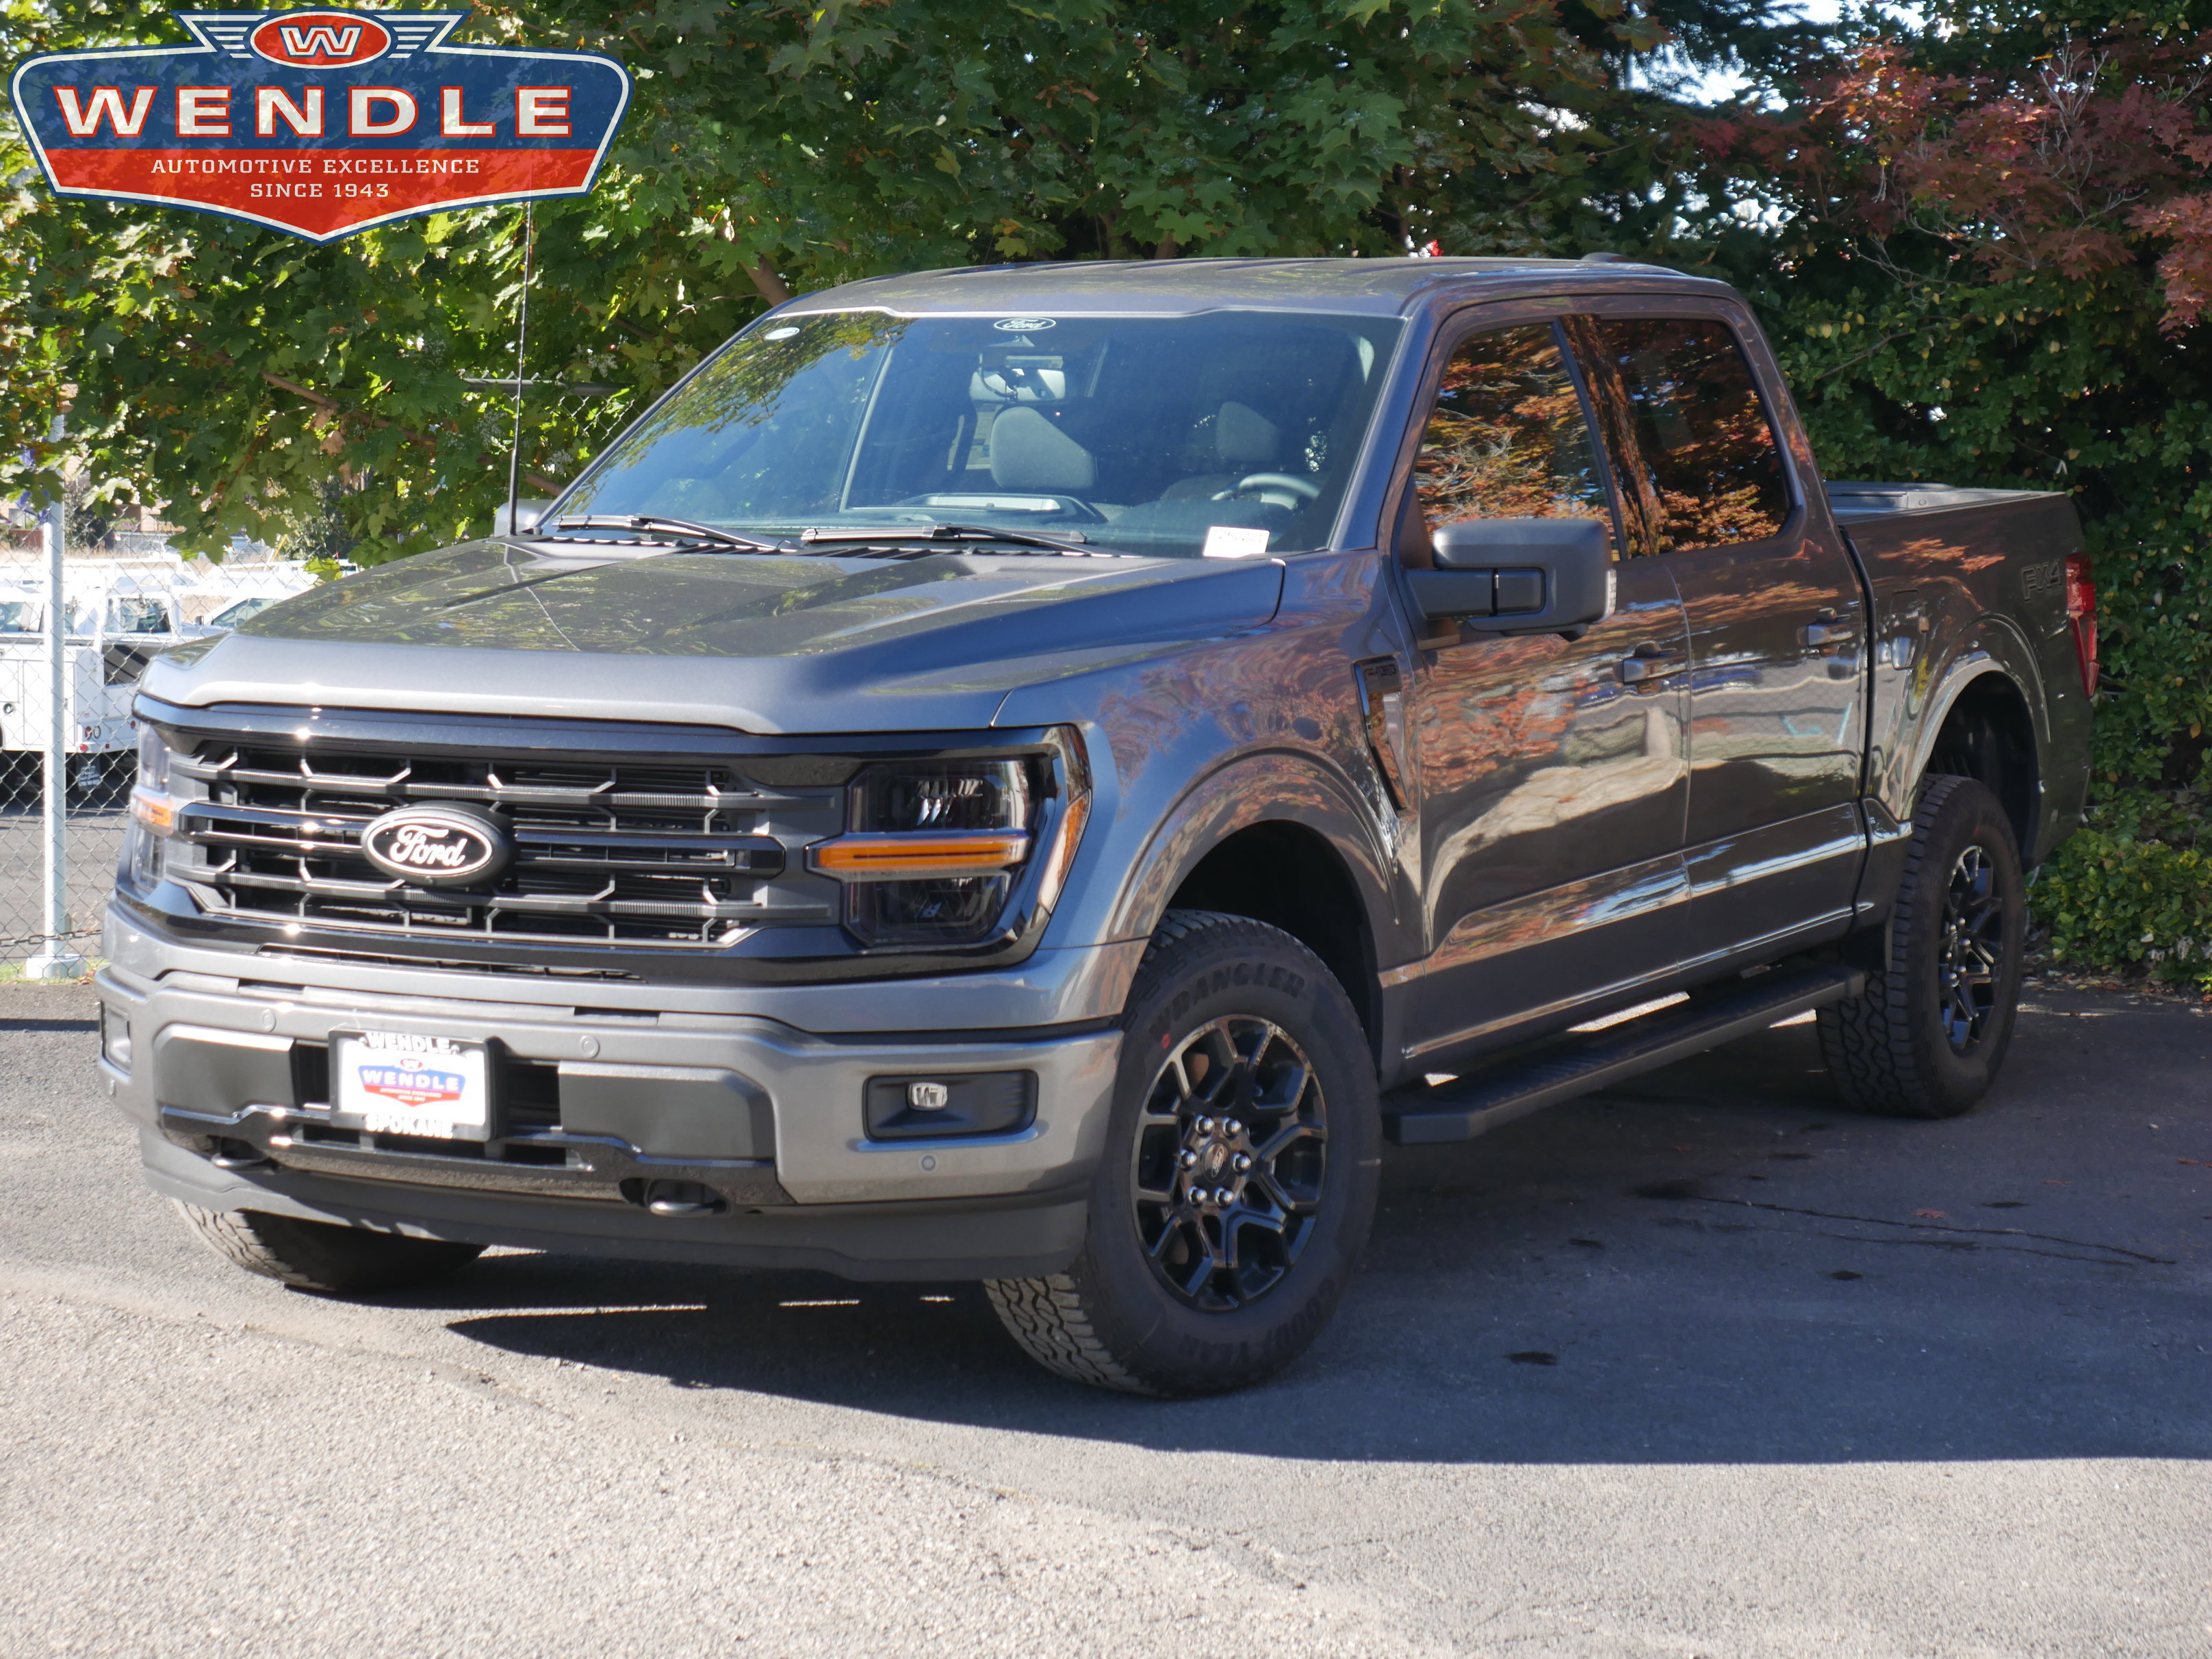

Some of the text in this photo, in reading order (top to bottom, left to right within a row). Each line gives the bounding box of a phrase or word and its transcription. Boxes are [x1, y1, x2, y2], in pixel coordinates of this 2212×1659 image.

[1003, 318, 1046, 329] Ford
[2021, 558, 2063, 604] FX4
[389, 824, 467, 866] Ford
[1148, 962, 1305, 1042] WRANGLER
[365, 1031, 452, 1055] WENDLE
[362, 1069, 459, 1091] WENDLE
[365, 1114, 453, 1139] SPOKANE
